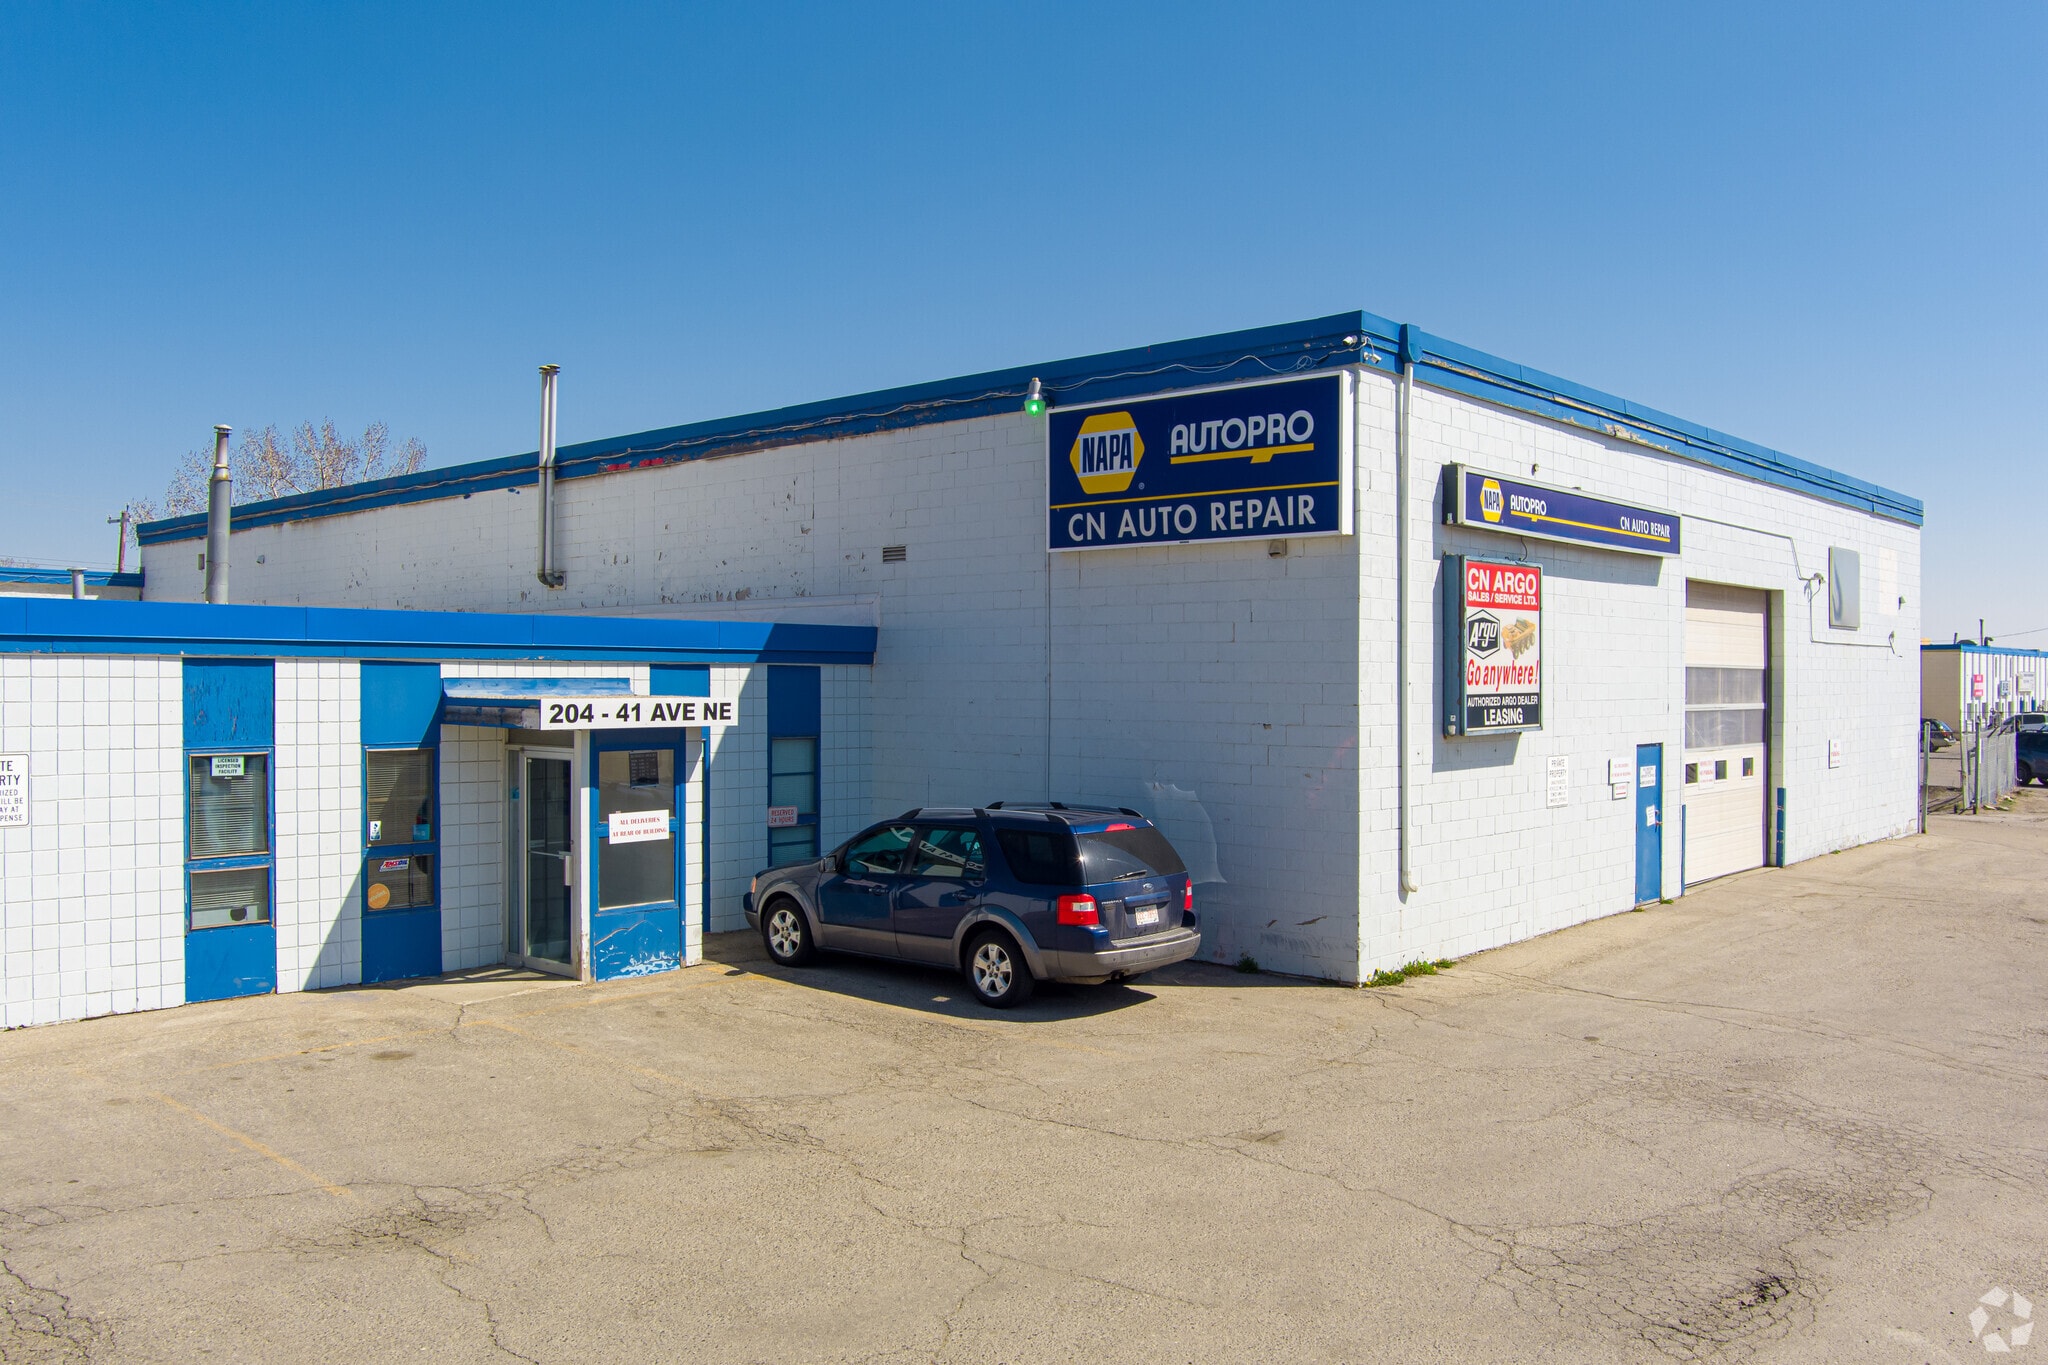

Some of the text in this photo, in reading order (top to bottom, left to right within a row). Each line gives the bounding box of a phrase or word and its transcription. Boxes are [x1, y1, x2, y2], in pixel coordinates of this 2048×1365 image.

[1170, 409, 1315, 455] AUTOPRO
[1081, 432, 1134, 474] NAPA
[1484, 489, 1501, 512] NAPA
[1510, 494, 1547, 516] AUTOPRO
[1068, 494, 1316, 542] CN AUTO REPAIR
[1620, 516, 1671, 538] CN AUTO REPAIR
[1467, 567, 1537, 595] CN ARGO
[1467, 590, 1490, 603] SALES
[1494, 592, 1523, 605] SERVICE
[1469, 621, 1498, 648] Argo
[1467, 658, 1481, 686] Go
[1467, 695, 1538, 708] AUTHORIZED ARGO DEALER
[549, 703, 594, 724] 204
[615, 703, 641, 722] 41
[650, 702, 696, 722] AVE
[703, 702, 732, 721] NE
[1484, 707, 1524, 726] LEASING
[0, 760, 13, 771] TE
[383, 859, 408, 868] AMSOIL
